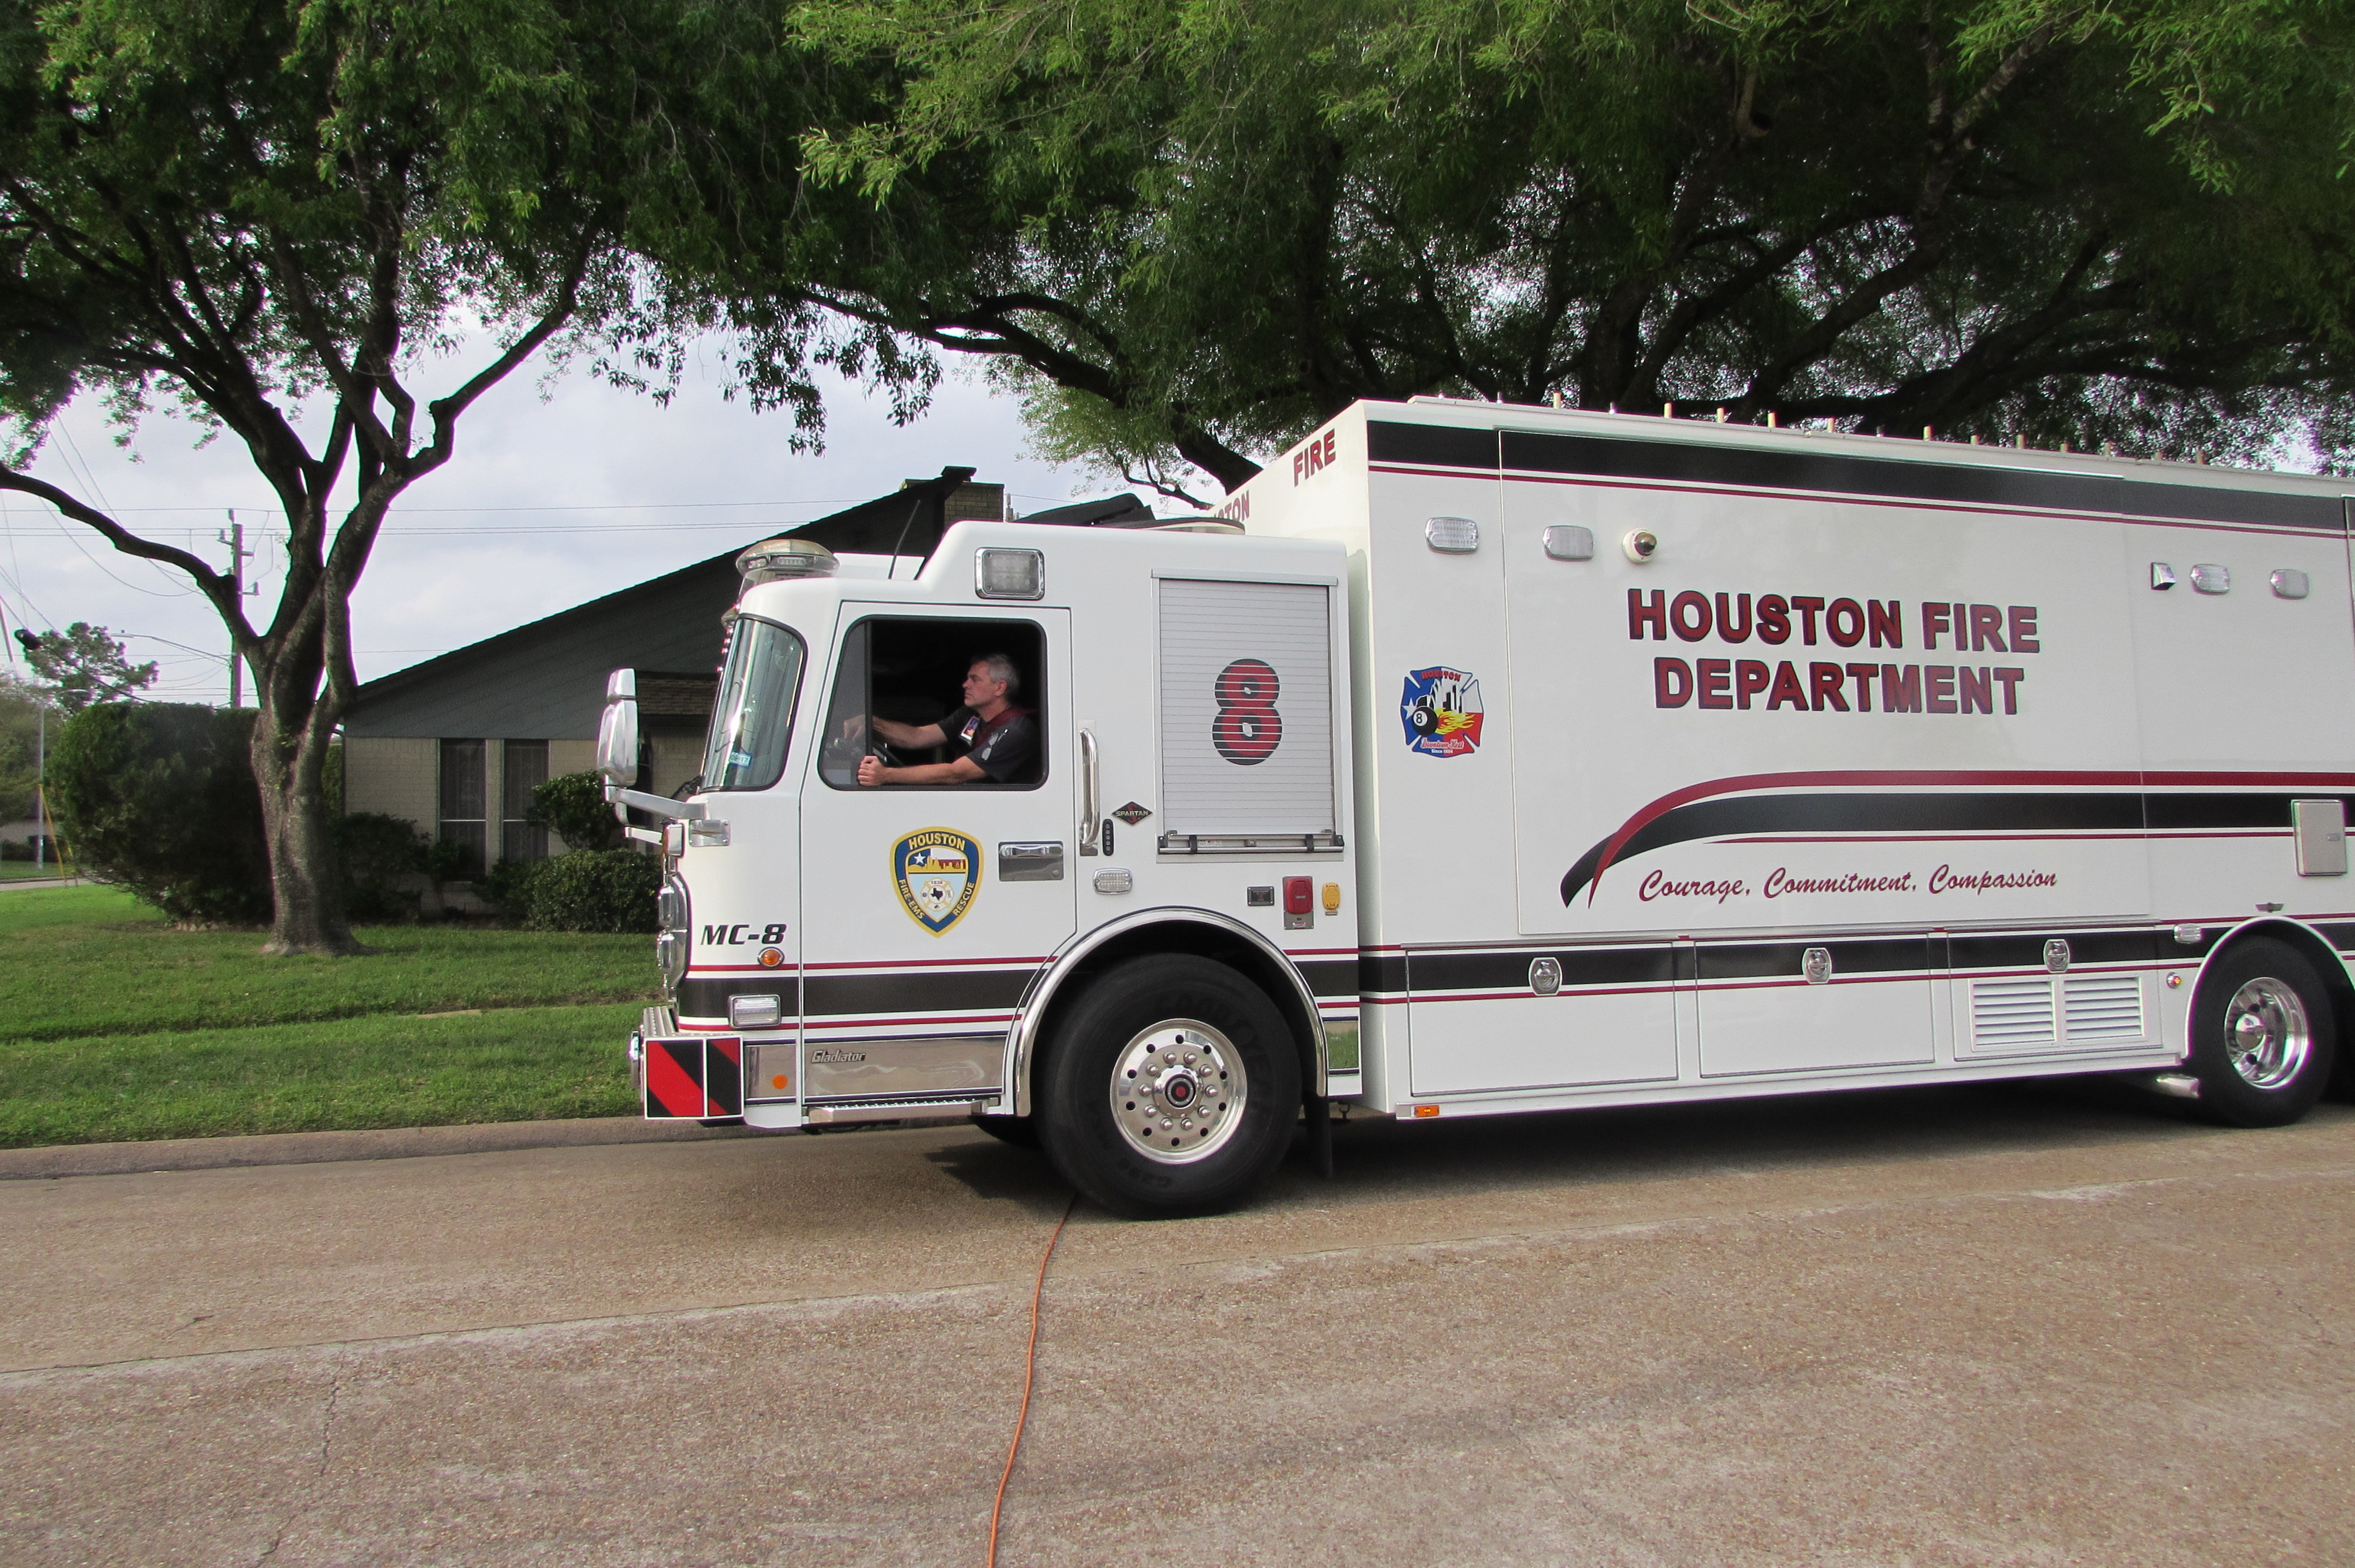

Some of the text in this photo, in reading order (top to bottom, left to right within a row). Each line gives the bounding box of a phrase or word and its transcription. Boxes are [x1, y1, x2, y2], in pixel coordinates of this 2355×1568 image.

[1293, 428, 1336, 487] FIRE
[1628, 588, 2040, 653] HOUSTON FIRE
[1421, 669, 1461, 682] HOUSTON
[1654, 657, 2025, 715] DEPARTMENT
[1212, 659, 1282, 766] 8
[1415, 713, 1423, 723] 8
[1421, 738, 1450, 749] Downtown
[908, 833, 966, 851] HOUSTON
[898, 879, 925, 919] FIRE-EMS
[953, 882, 974, 916] RESCUE
[1639, 864, 2058, 904] Courage, Commitment, Compassion
[700, 923, 787, 945] MC-8
[811, 1049, 866, 1064] Gladiator
